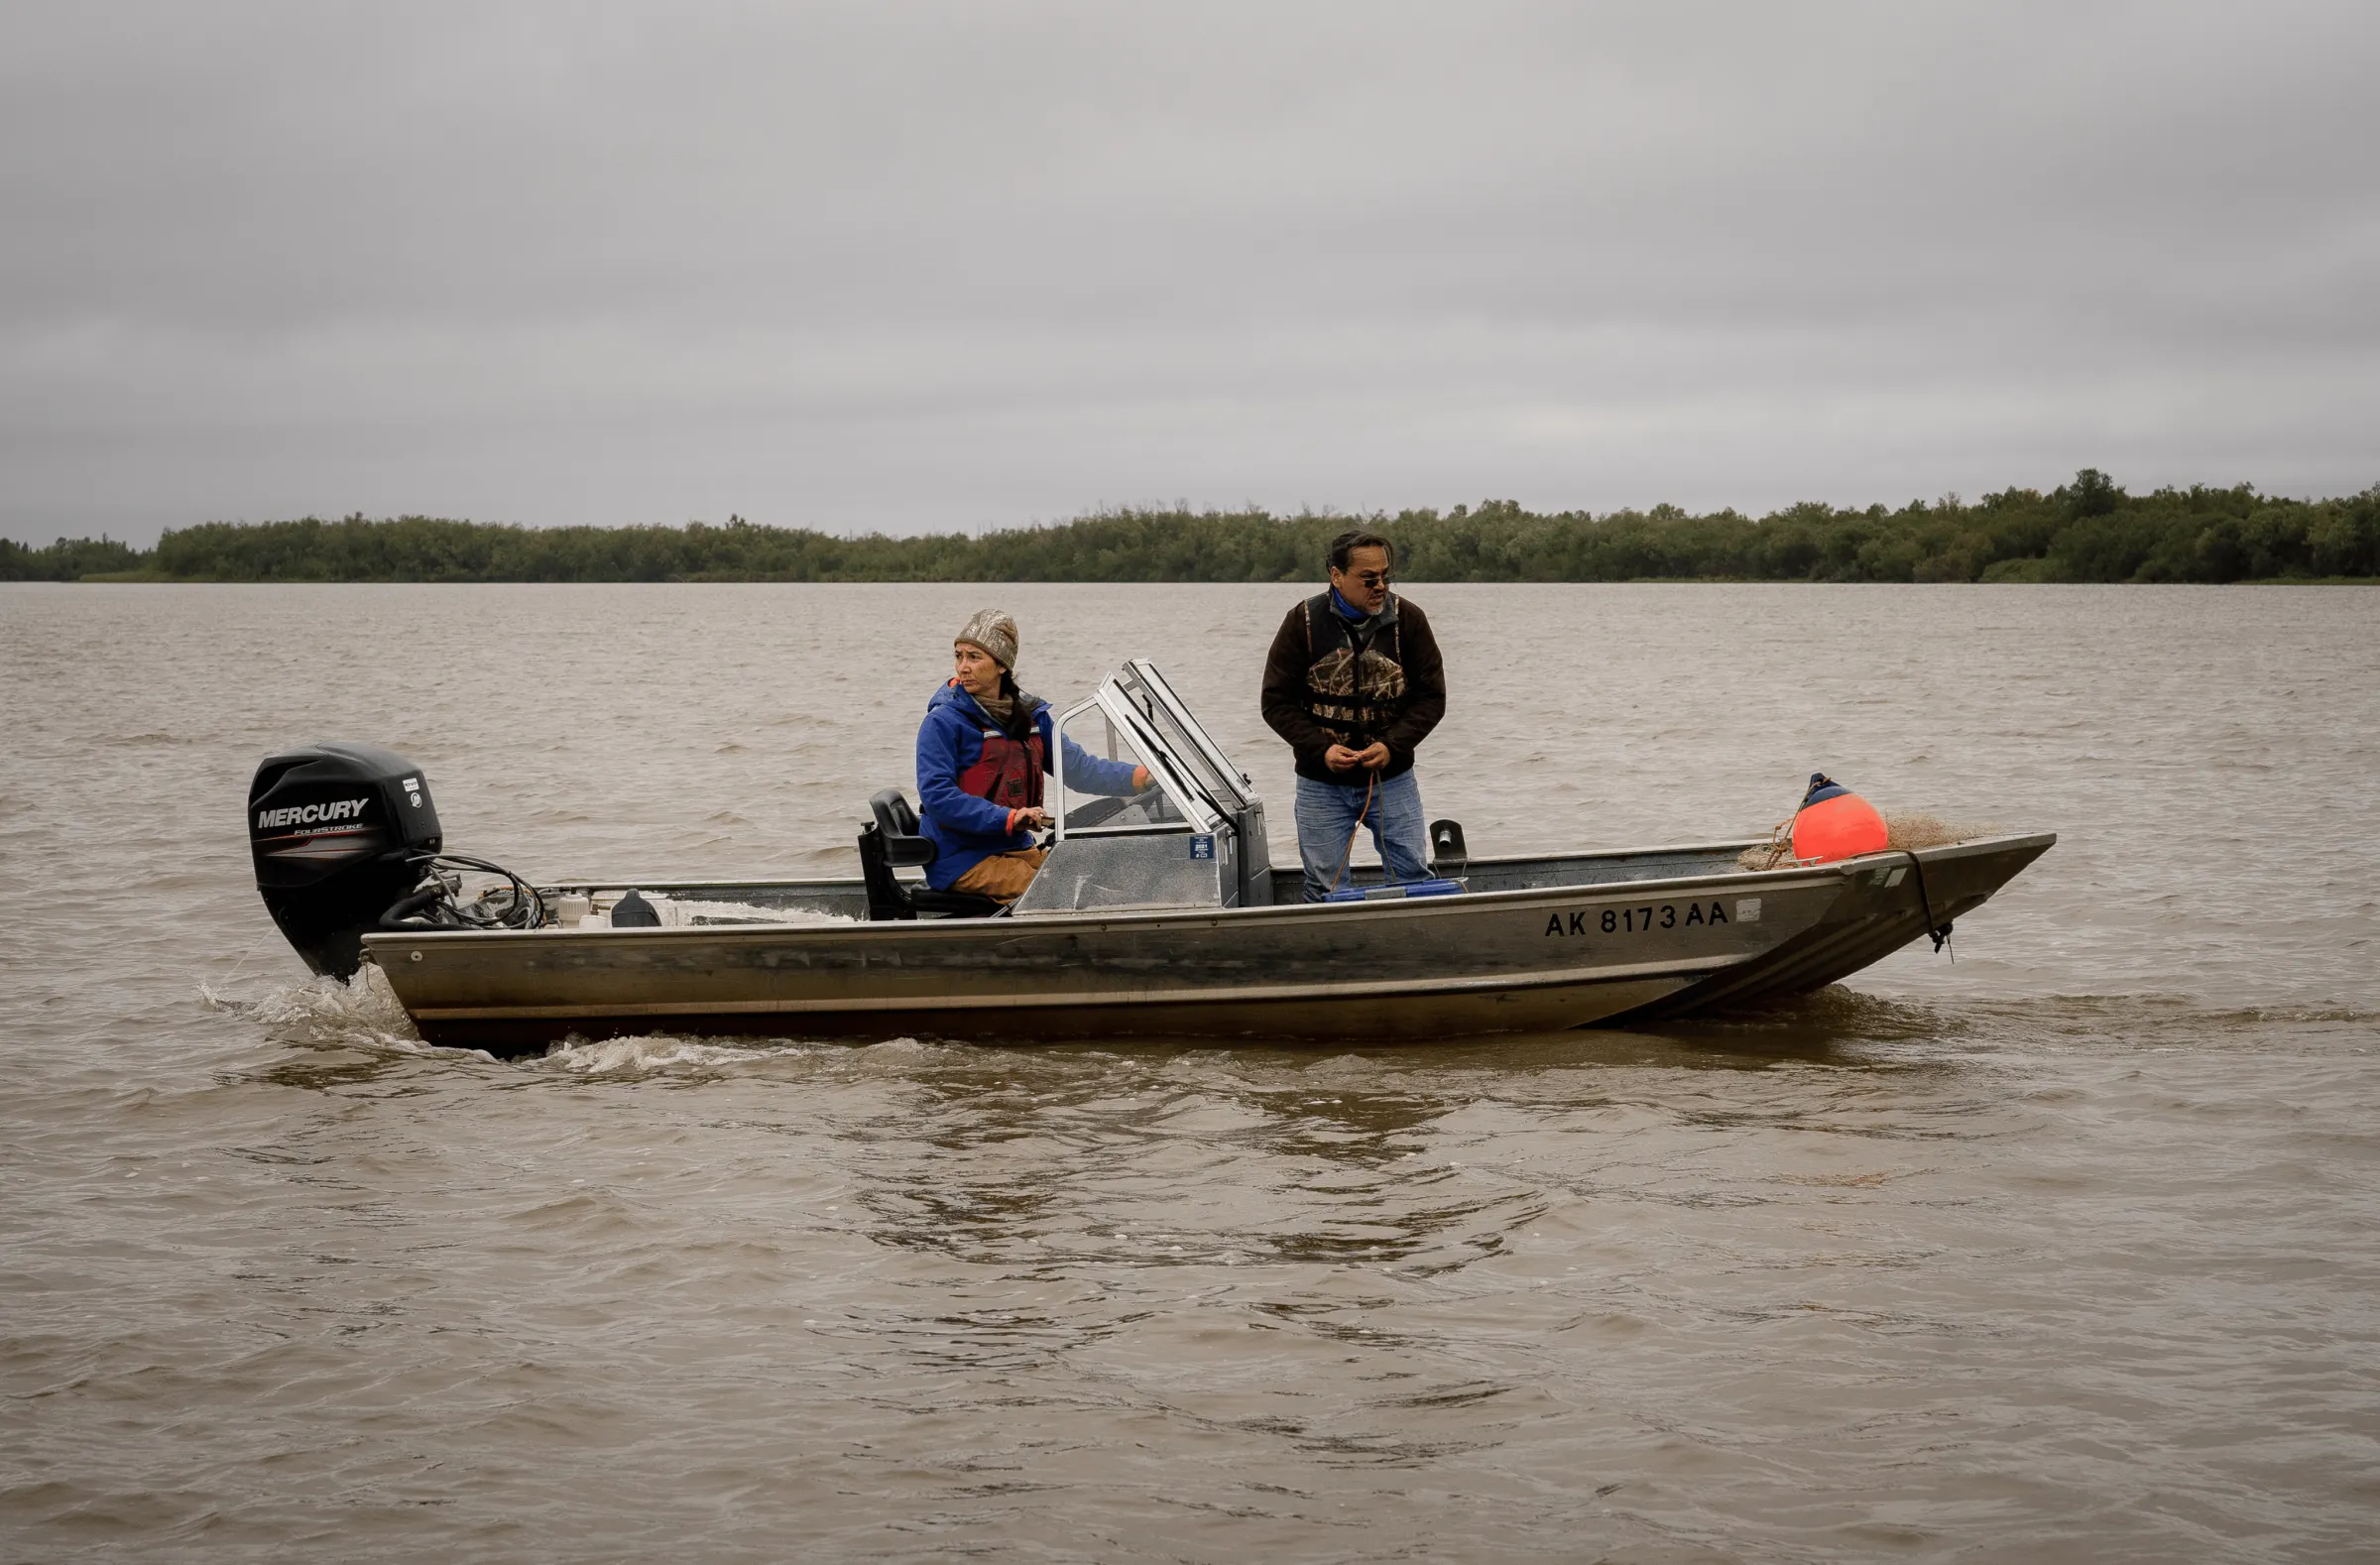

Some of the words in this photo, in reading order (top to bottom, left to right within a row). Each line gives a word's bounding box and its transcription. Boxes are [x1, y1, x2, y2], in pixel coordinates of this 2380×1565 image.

[258, 797, 369, 829] MERCURY
[294, 822, 364, 836] FOURSTROKE
[1545, 910, 1587, 937] AK
[1601, 904, 1677, 934] 8173
[1686, 901, 1728, 926] AA
